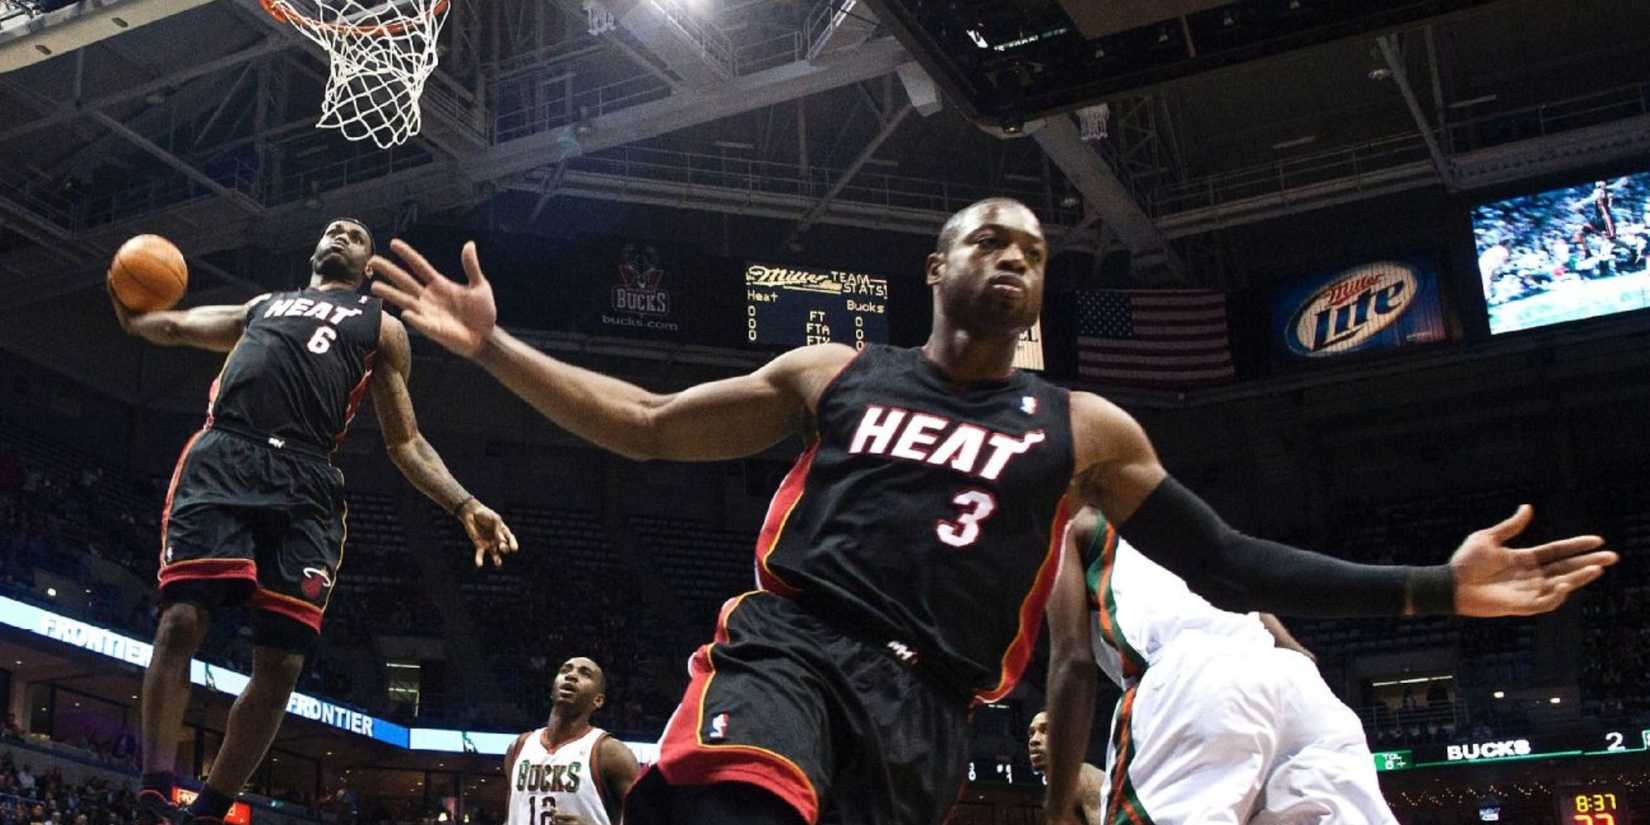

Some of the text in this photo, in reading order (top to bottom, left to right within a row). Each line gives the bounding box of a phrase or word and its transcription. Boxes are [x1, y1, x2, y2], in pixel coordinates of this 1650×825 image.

[831, 271, 870, 285] TEAM
[1325, 272, 1385, 307] Miller
[263, 298, 363, 326] HEAT
[616, 287, 667, 313] BUCKS
[747, 290, 885, 314] Heat Bucks
[602, 314, 679, 331] bucks.com
[806, 323, 831, 336] FTA
[809, 311, 826, 322] FT
[1312, 280, 1405, 352] Lite
[306, 325, 337, 355] 6
[848, 404, 1046, 481] HEAT
[935, 488, 996, 548] 3
[41, 610, 153, 667] FRONTIER
[286, 692, 373, 737] FRONTIER
[1446, 740, 1531, 761] BUCKS
[1605, 731, 1626, 752] 2
[516, 759, 582, 793] BUCKS
[1575, 794, 1617, 813] 8:37
